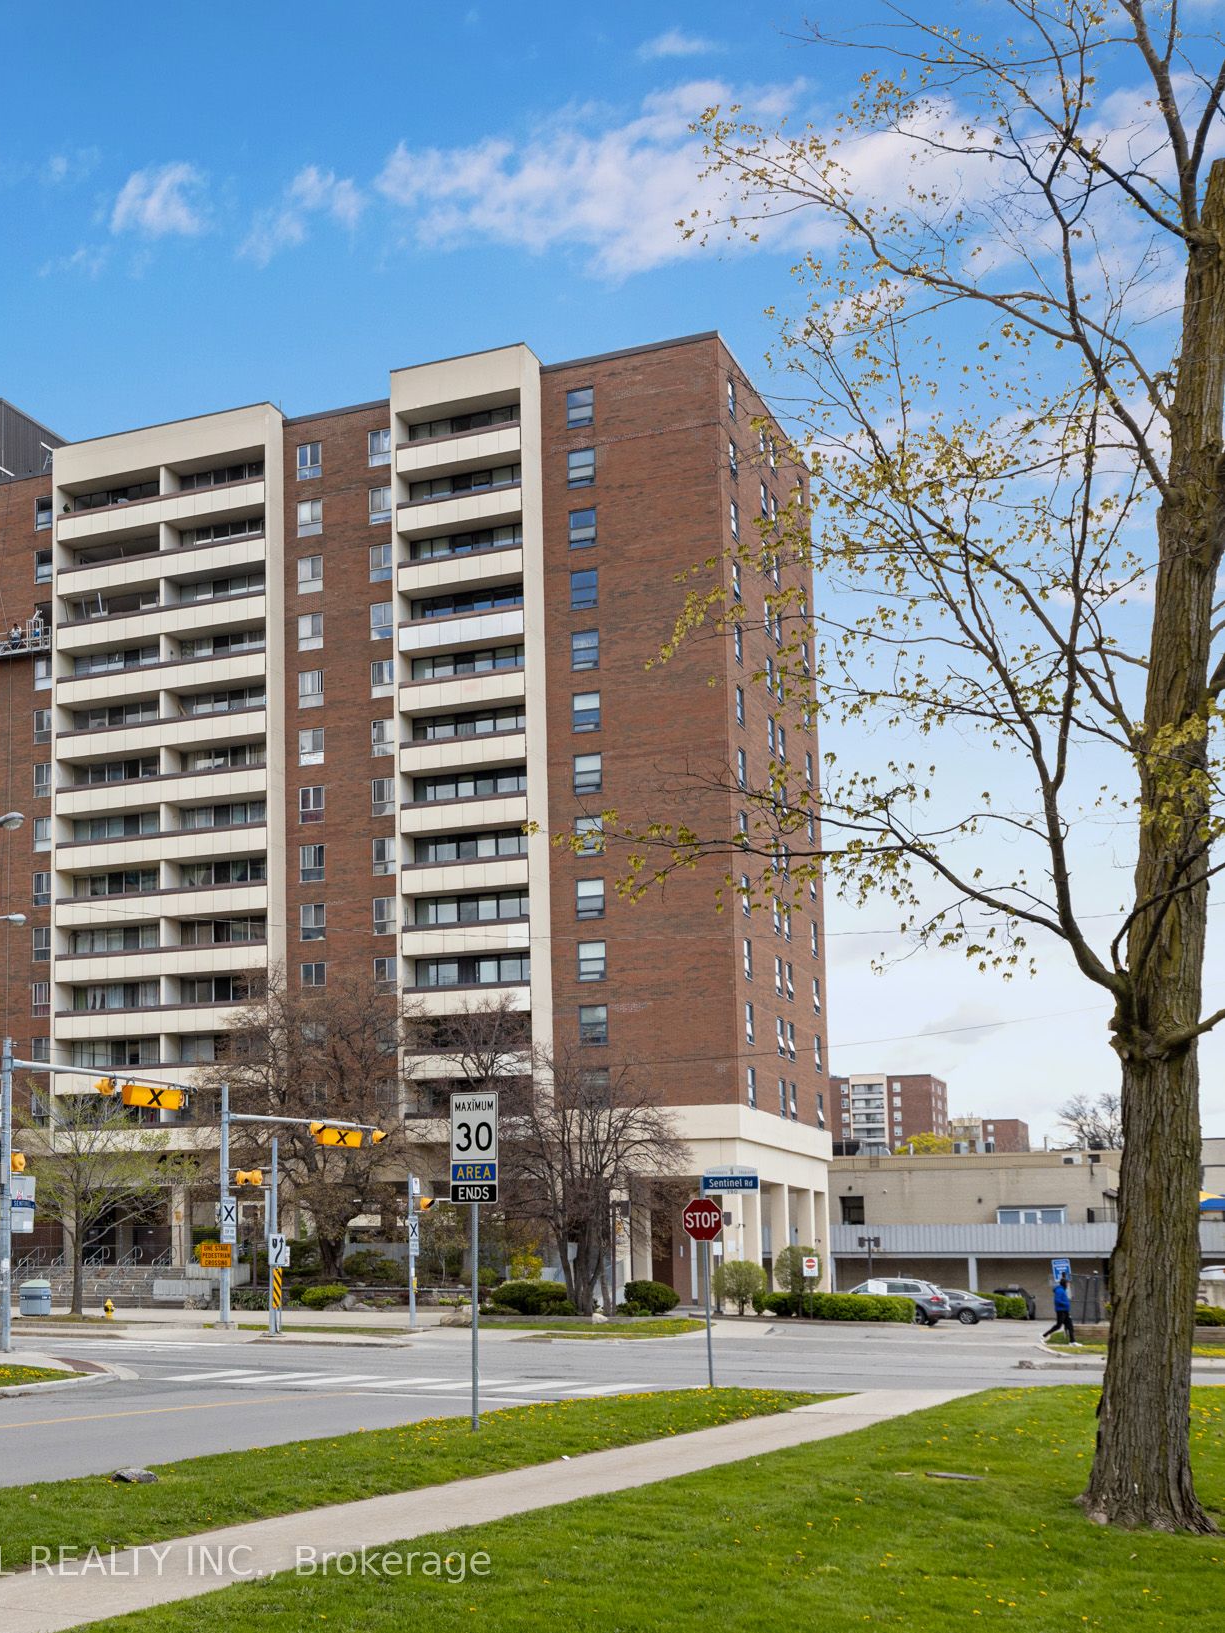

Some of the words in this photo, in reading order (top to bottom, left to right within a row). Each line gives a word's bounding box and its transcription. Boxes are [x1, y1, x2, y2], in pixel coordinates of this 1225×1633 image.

[454, 1100, 494, 1112] MAXIMUM
[456, 1122, 493, 1152] 30
[456, 1166, 492, 1179] AREA
[709, 1179, 743, 1188] Sentinel
[744, 1179, 754, 1187] Rd
[458, 1186, 490, 1200] ENDS
[685, 1211, 720, 1229] STOP
